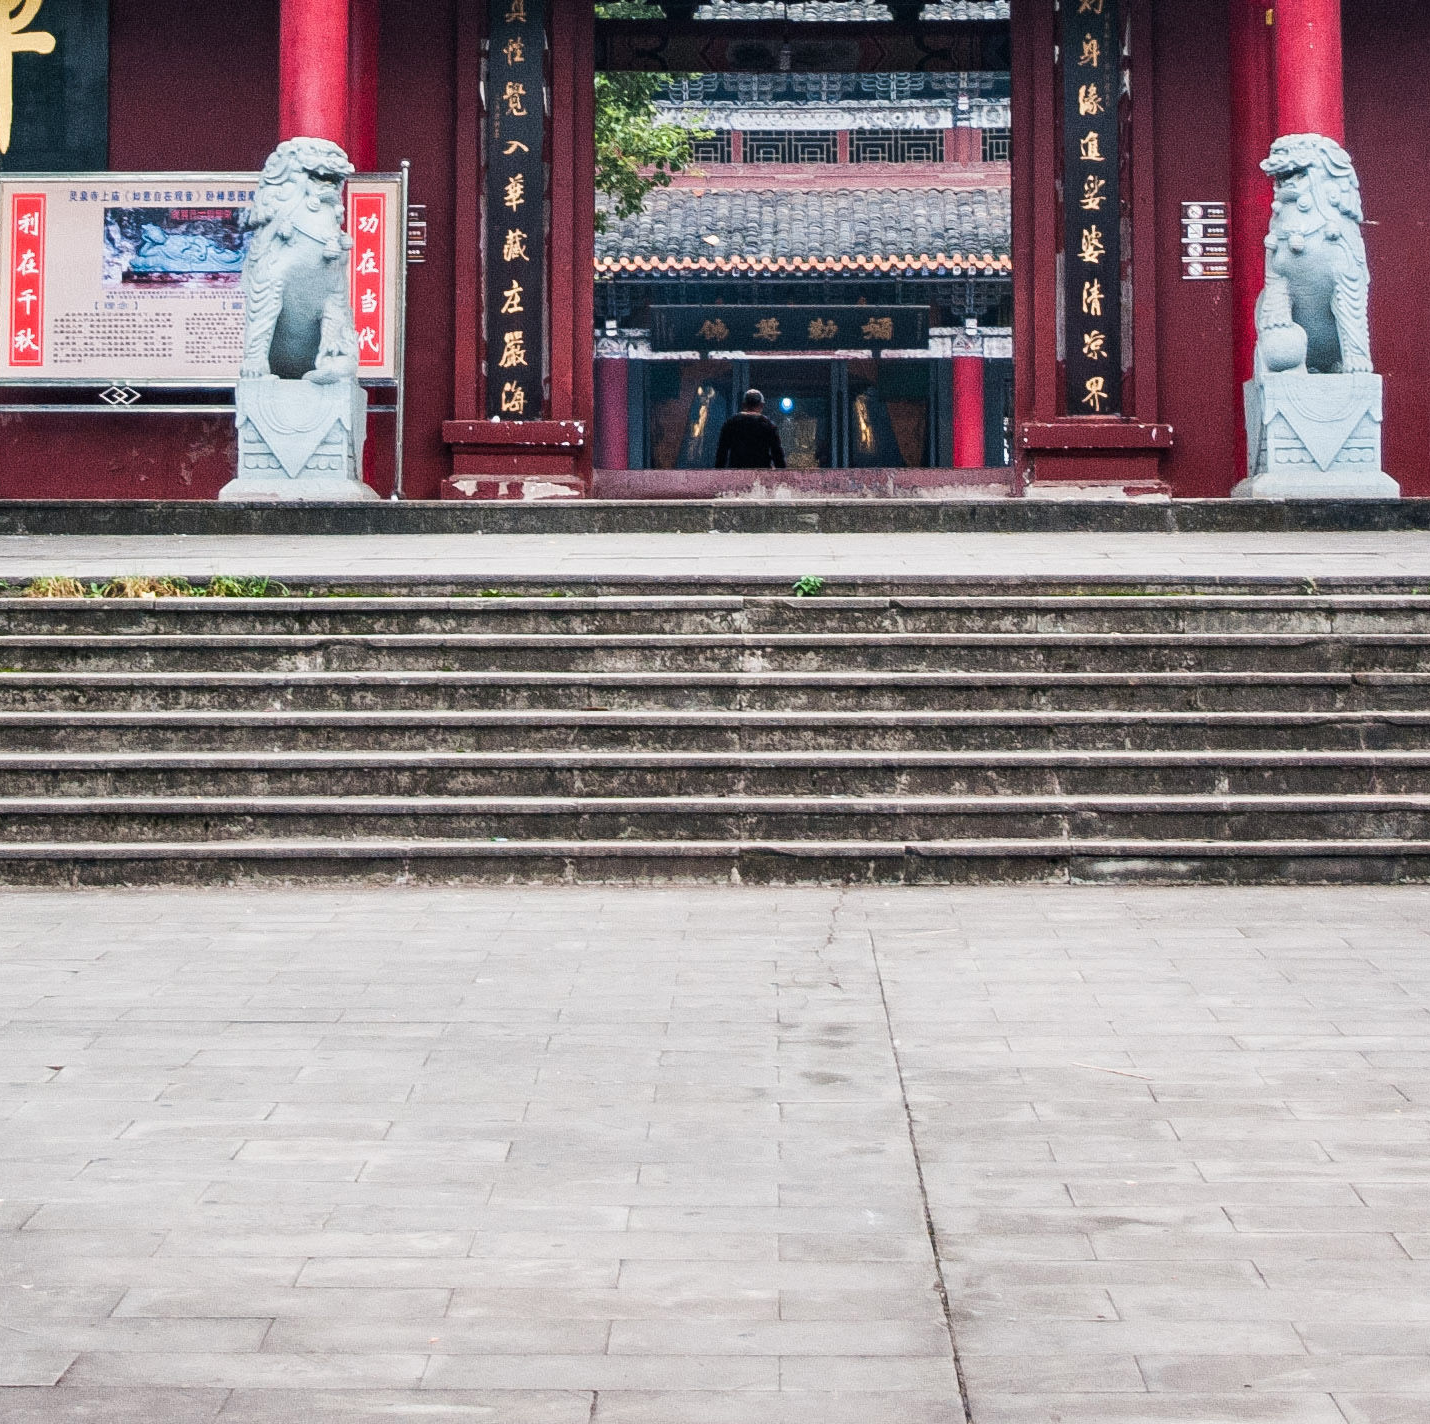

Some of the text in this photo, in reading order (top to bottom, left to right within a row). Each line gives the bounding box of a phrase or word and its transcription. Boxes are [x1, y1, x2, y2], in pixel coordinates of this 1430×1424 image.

[14, 211, 40, 353] 利在千秋
[356, 213, 380, 353] 功在当代
